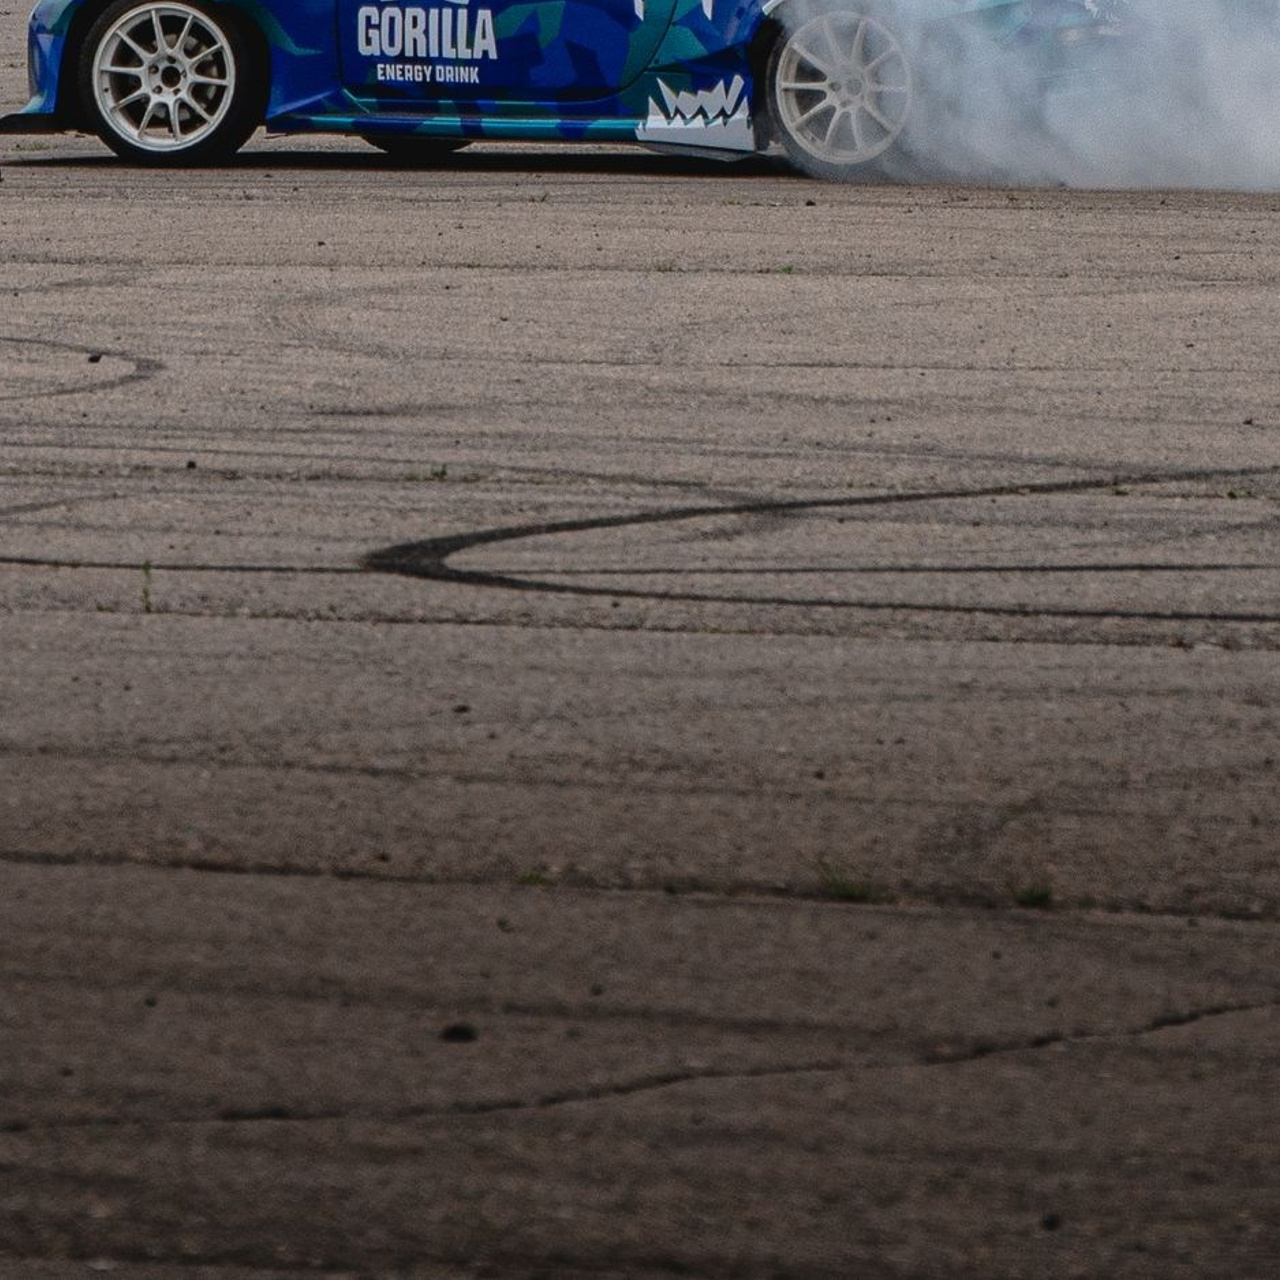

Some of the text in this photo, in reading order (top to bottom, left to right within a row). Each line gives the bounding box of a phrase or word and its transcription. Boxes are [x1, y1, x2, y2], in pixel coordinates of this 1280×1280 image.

[357, 6, 498, 60] GORILLA
[377, 63, 480, 84] ENERGY DRINK
